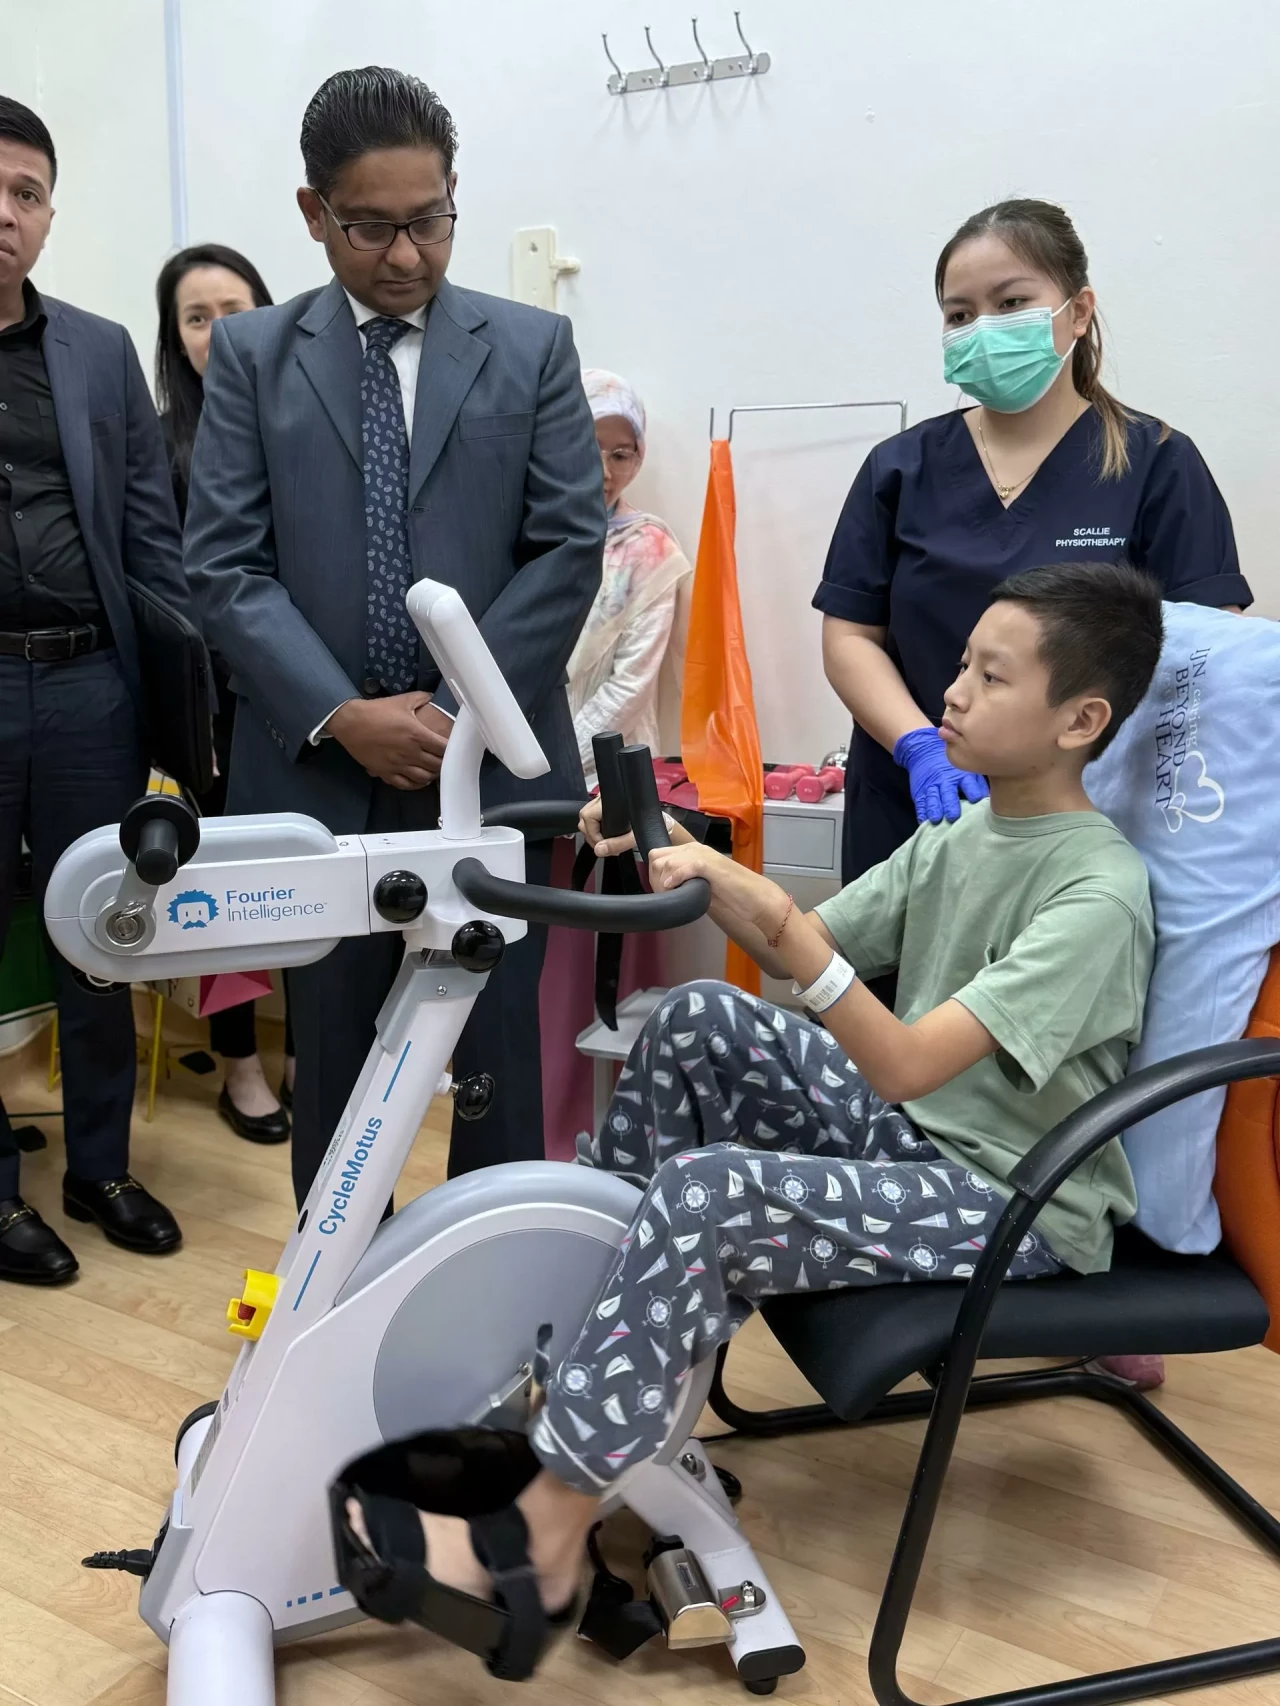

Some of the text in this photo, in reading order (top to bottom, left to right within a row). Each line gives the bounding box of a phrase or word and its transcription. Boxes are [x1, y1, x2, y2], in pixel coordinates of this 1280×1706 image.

[1055, 537, 1126, 547] PHYSIOTHERAPY
[1073, 527, 1111, 537] SCALLIE
[1171, 667, 1190, 768] BEYOND
[1186, 688, 1201, 748] caring
[1155, 707, 1175, 810] HEART
[226, 886, 296, 904] Fourier
[227, 901, 326, 922] Intelligence
[318, 1117, 383, 1235] CycleMotus
